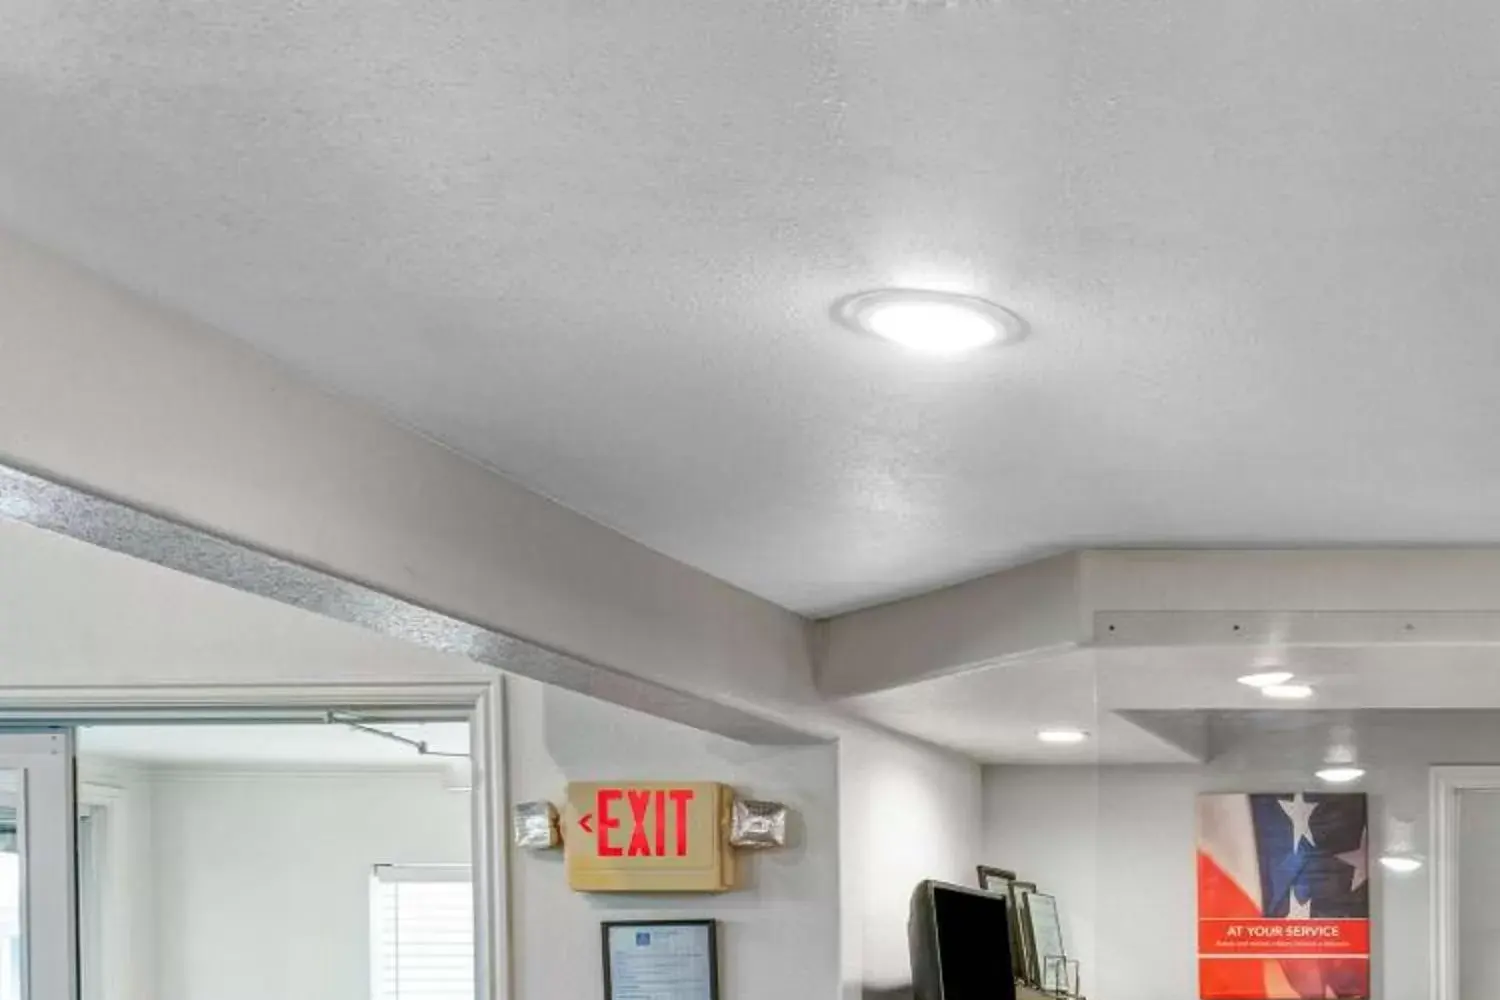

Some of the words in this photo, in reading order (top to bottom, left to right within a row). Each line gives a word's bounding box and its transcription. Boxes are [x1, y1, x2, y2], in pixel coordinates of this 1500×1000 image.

[597, 788, 694, 857] EXIT
[1227, 925, 1242, 937] AT
[1247, 925, 1283, 937] YOUR
[1285, 925, 1340, 937] SERVICE
